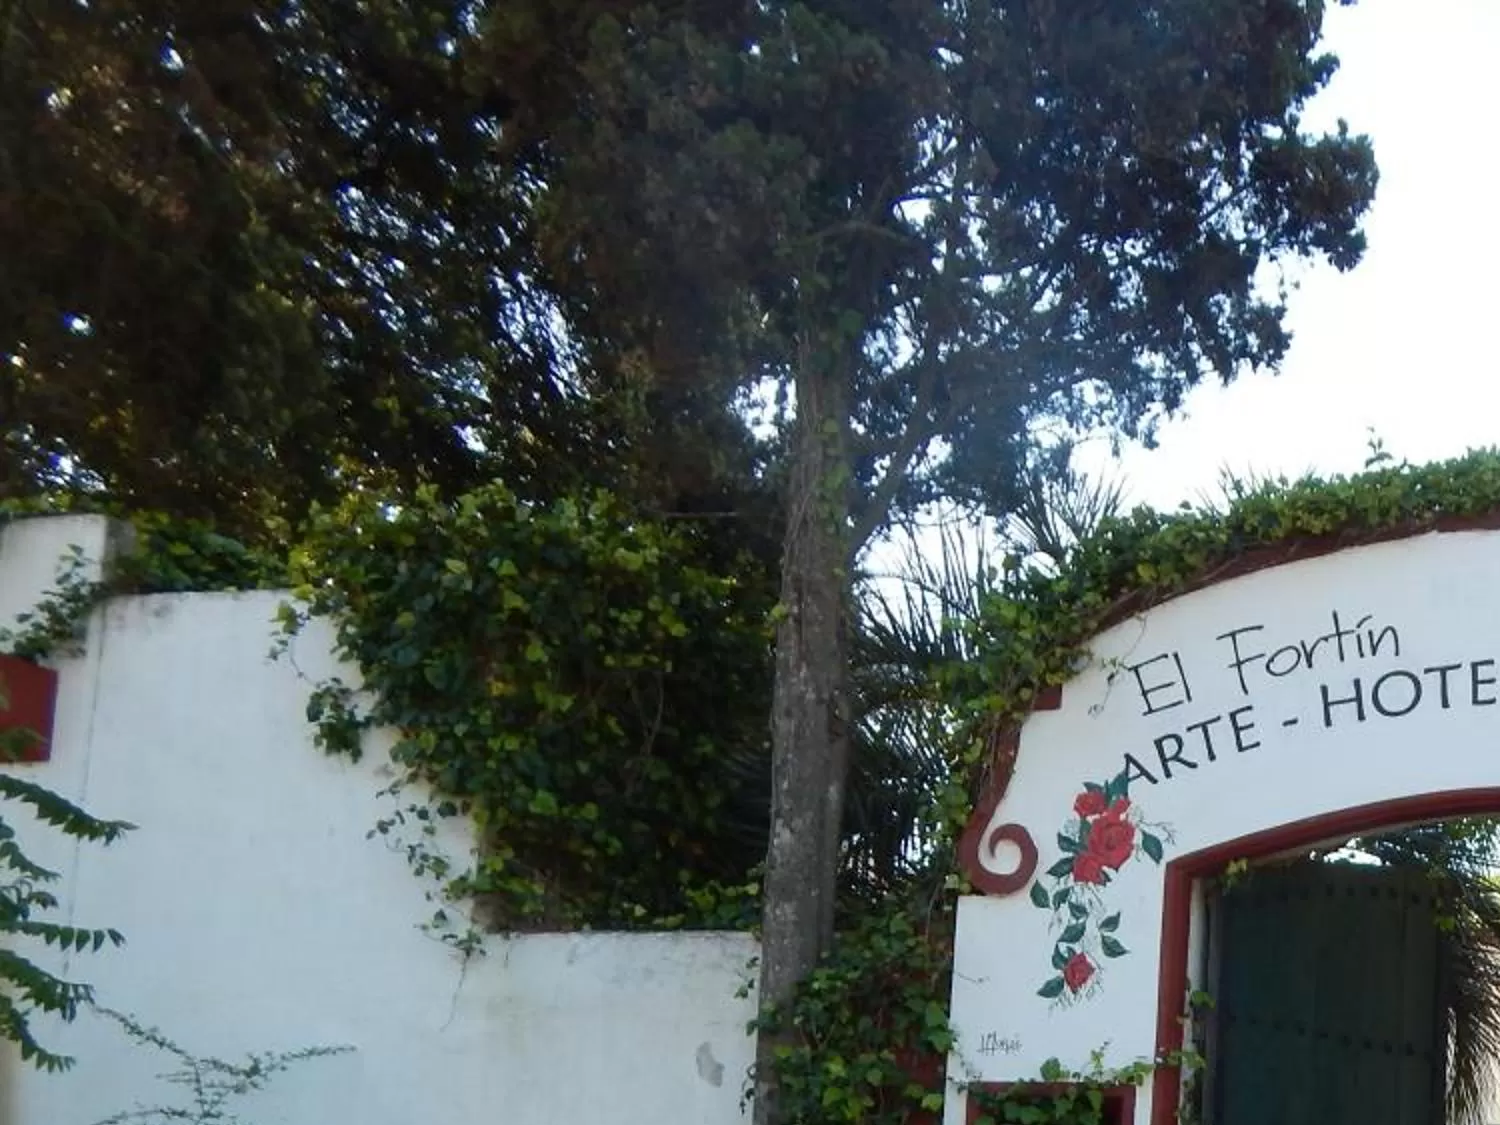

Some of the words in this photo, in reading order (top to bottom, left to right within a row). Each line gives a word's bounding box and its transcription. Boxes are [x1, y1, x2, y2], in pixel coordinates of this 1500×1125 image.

[1127, 651, 1193, 717] El
[1216, 609, 1401, 696] Fortín
[1122, 705, 1262, 787] ARTE
